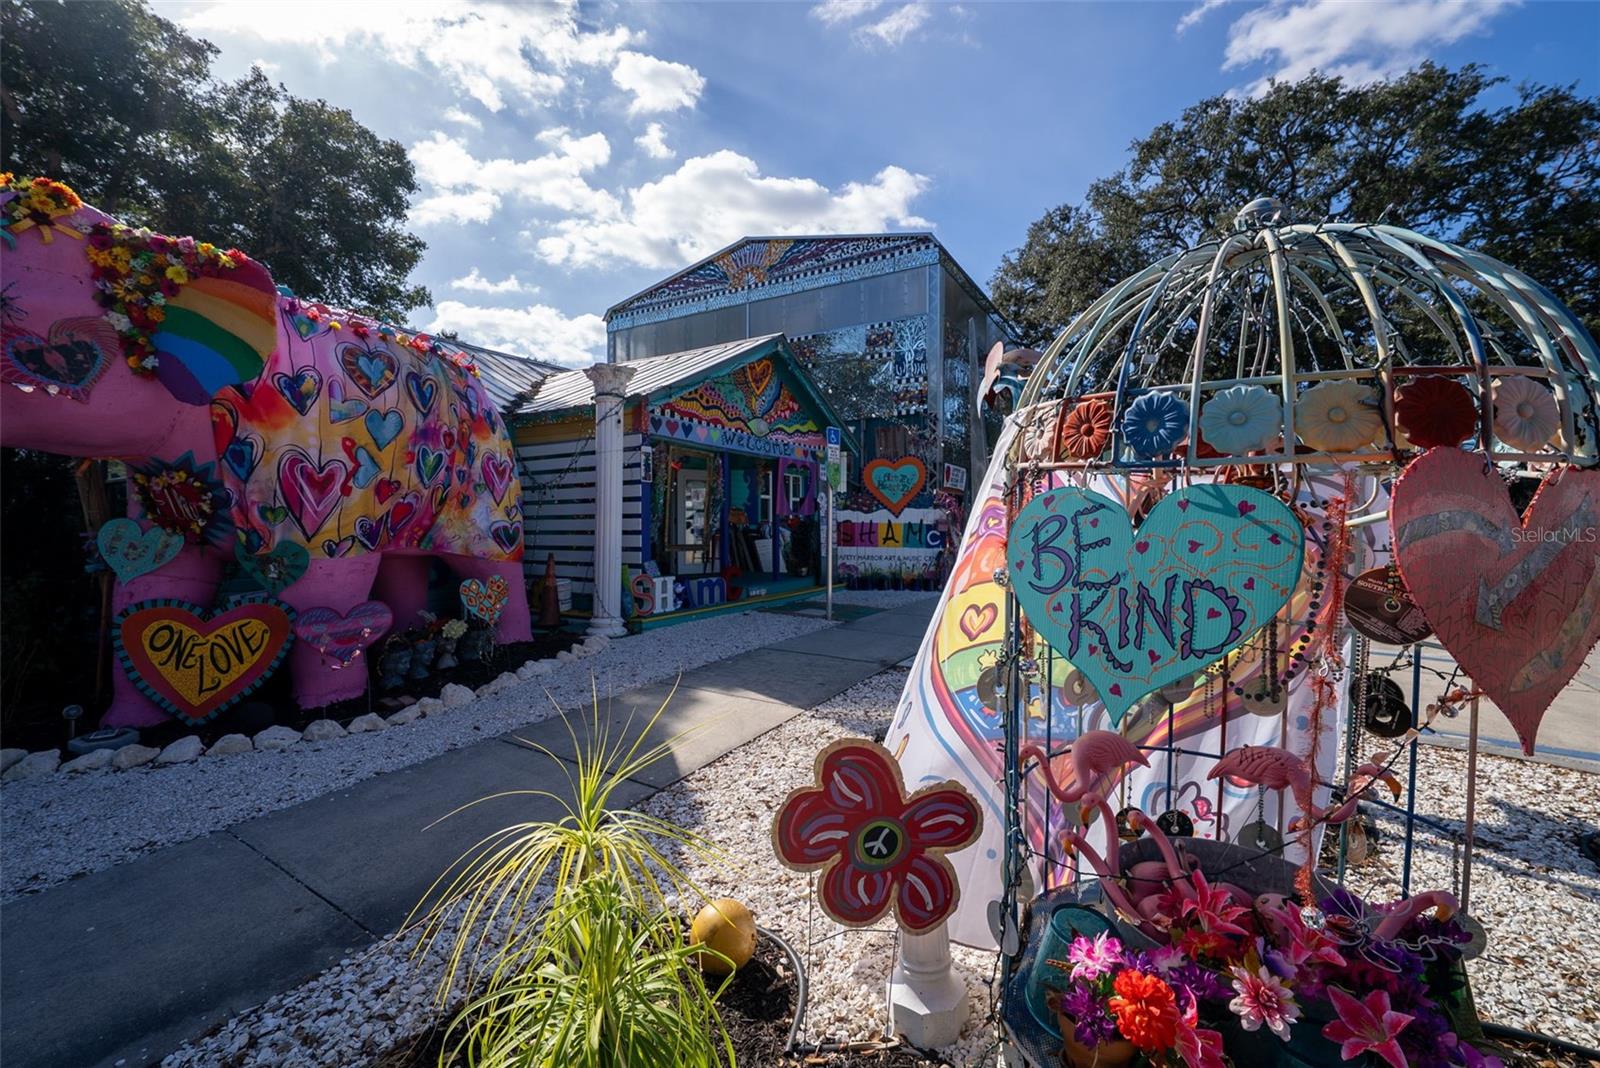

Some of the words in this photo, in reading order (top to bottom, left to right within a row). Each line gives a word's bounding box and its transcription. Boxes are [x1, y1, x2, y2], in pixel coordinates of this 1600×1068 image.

[1021, 503, 1121, 595] BE
[149, 624, 210, 671] ONE
[198, 620, 269, 696] LOVE
[1068, 573, 1247, 673] KIND
